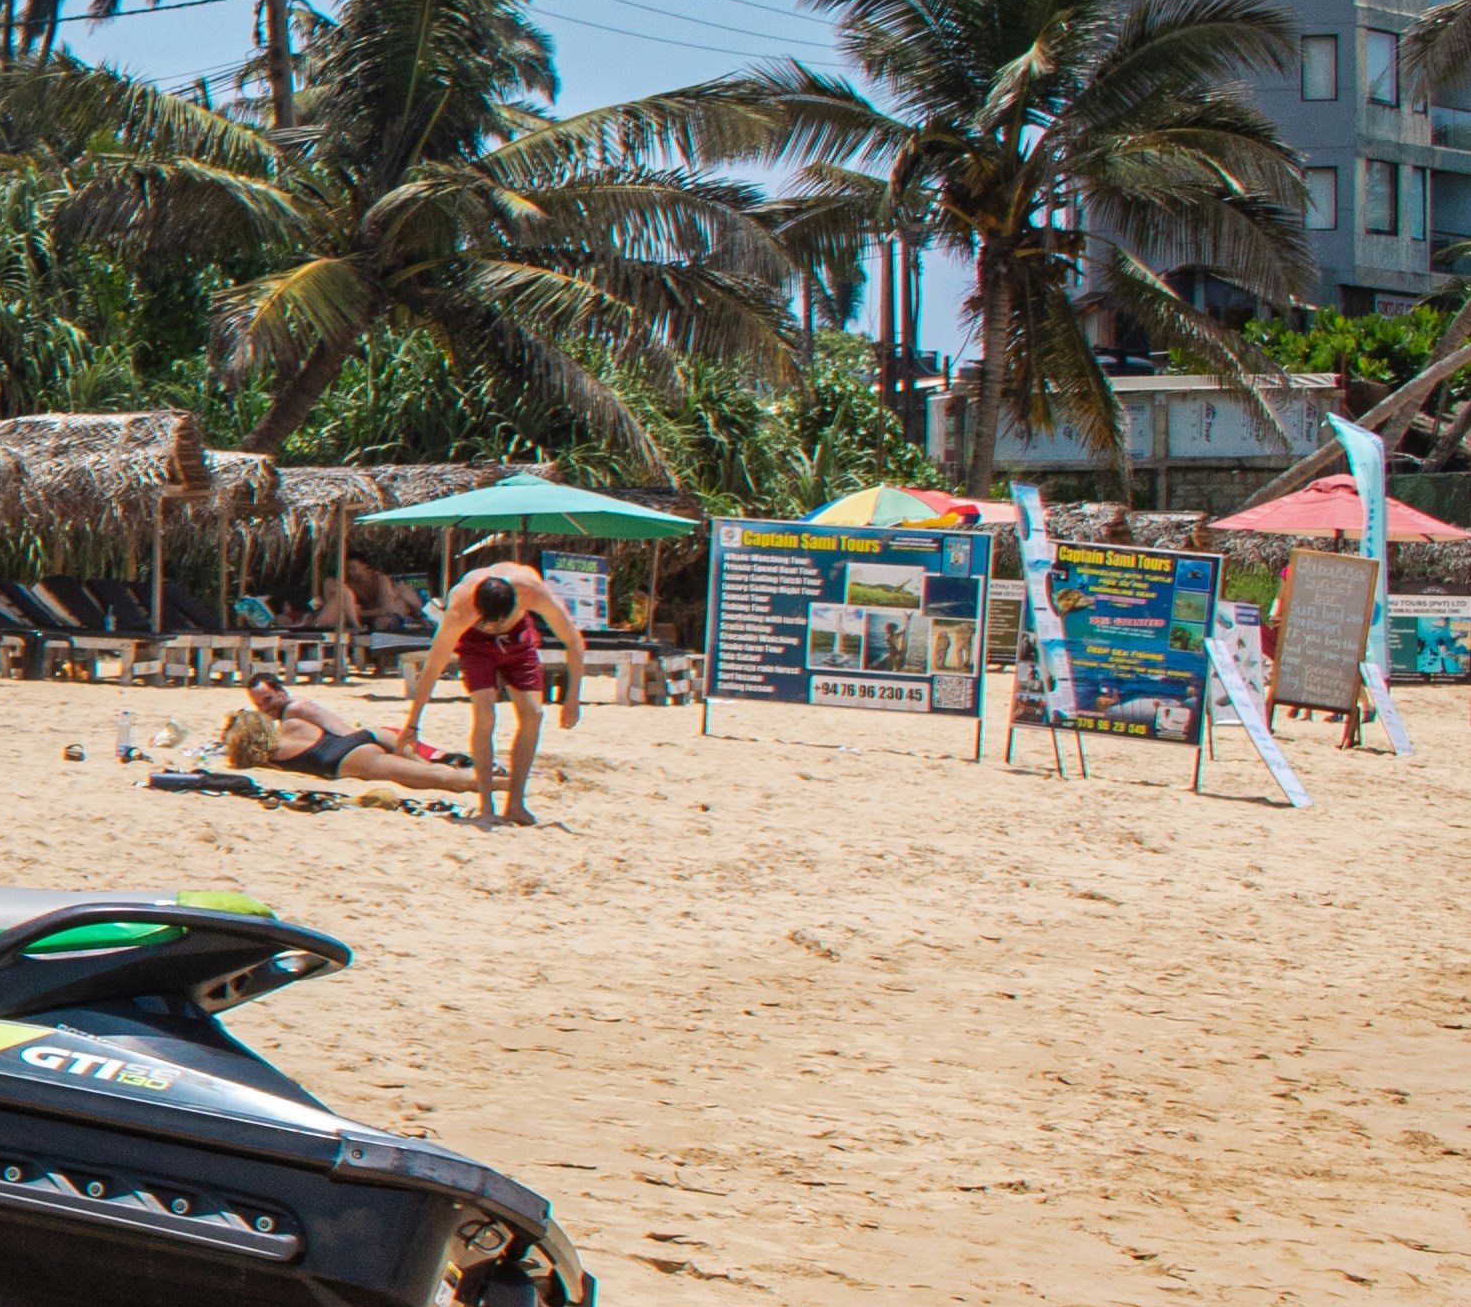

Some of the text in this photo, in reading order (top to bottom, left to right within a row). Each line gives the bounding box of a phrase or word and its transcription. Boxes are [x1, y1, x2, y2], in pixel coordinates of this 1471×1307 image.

[743, 530, 799, 548] Captain
[800, 532, 838, 550] Sami
[840, 535, 881, 552] Tours
[1059, 546, 1172, 572] Captain Sami Tours
[814, 682, 922, 701] +94 76 96 230 45
[20, 1046, 126, 1081] GTI
